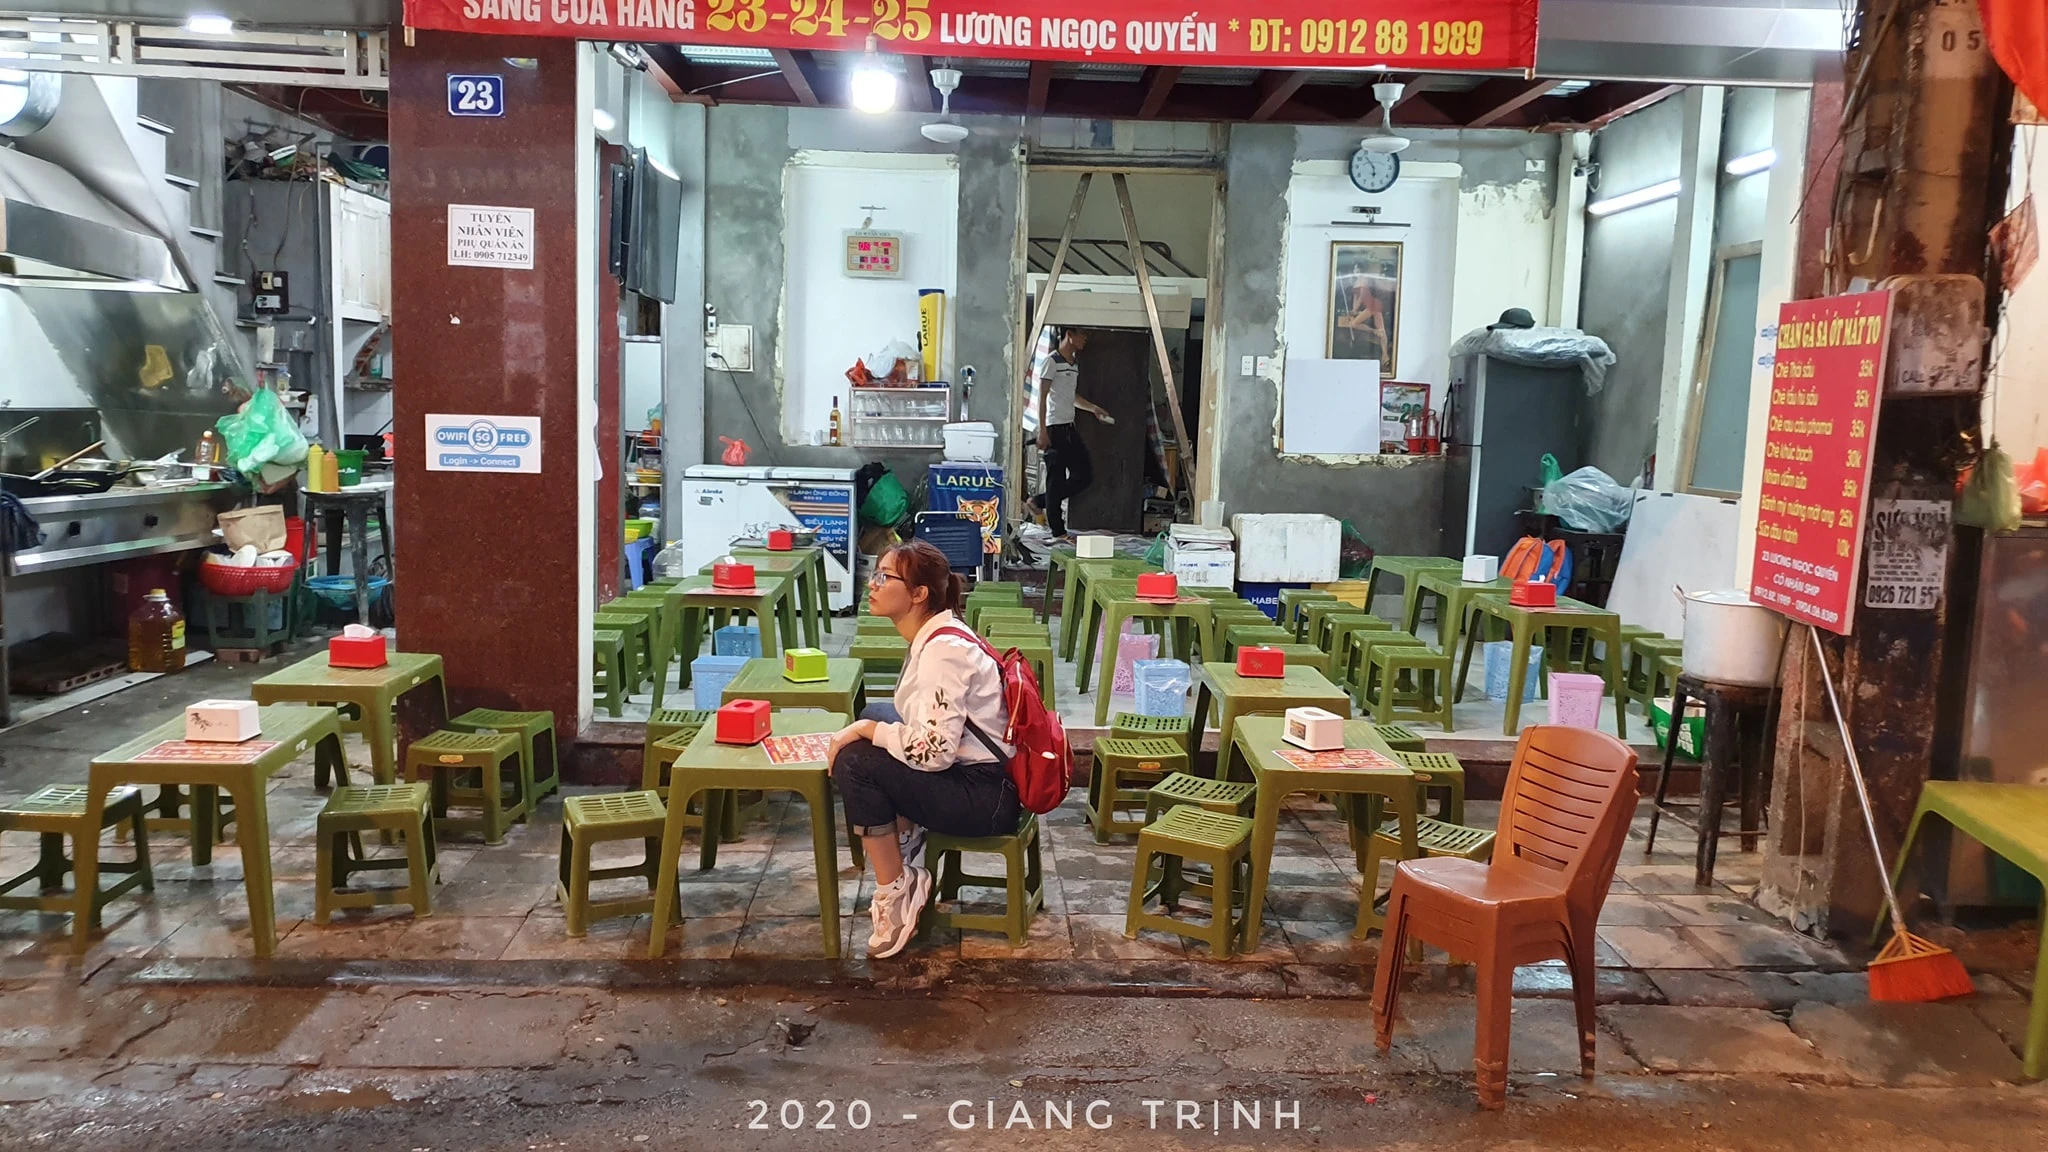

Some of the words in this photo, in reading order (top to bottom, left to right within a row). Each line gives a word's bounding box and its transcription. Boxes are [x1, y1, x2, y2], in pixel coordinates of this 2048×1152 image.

[939, 14, 1032, 47] LƯƠNG
[1040, 18, 1117, 56] NGỌC
[1125, 12, 1217, 53] QUYẾN
[1249, 18, 1292, 53] ĐT:
[1300, 18, 1366, 54] 0912
[1374, 19, 1408, 54] 88
[1419, 20, 1482, 56] 1989
[458, 81, 494, 110] 23
[458, 224, 492, 236] NHÂN
[495, 226, 524, 237] VIÊN
[457, 239, 477, 248] PHỤ
[480, 239, 508, 249] QUÁN
[454, 250, 471, 258] LH:
[474, 251, 495, 259] 0905
[497, 252, 528, 260] 712349
[920, 307, 928, 347] LARUE
[1777, 315, 1802, 349] CHÂN
[1802, 313, 1815, 348] GÀ
[1829, 311, 1843, 347] ỚT
[1866, 315, 1881, 345] TO
[1775, 361, 1789, 378] Chè
[1772, 388, 1785, 405] Chè
[1769, 414, 1783, 432] Chè
[437, 432, 467, 441] OWIFI
[475, 433, 491, 441] 5G
[500, 433, 527, 443] FREE
[1766, 441, 1780, 458] Chè
[443, 457, 468, 466] Login
[480, 457, 516, 466] Connect
[936, 475, 995, 488] LARUE
[1868, 585, 1895, 603] 0926
[1899, 586, 1917, 604] 721
